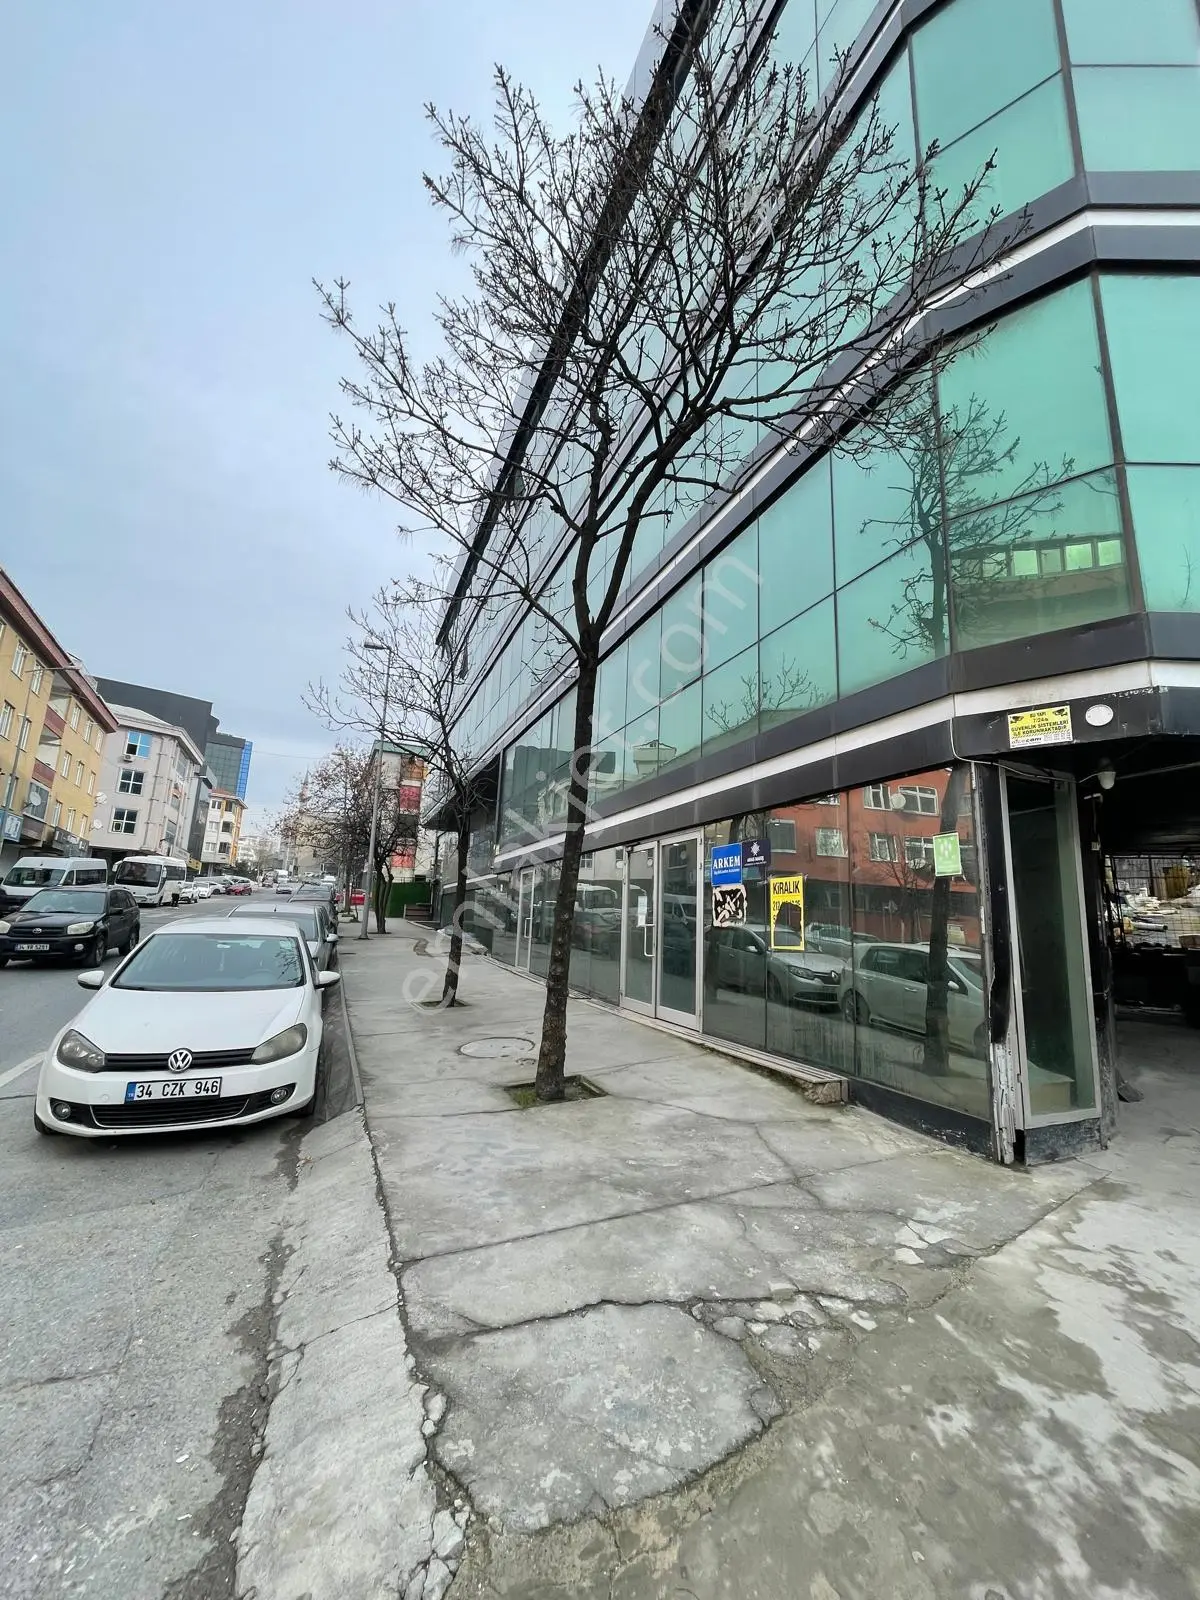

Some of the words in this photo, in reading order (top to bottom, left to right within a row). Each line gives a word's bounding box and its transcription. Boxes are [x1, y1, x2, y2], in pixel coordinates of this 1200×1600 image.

[713, 856, 741, 869] ARKEM
[136, 1084, 152, 1099] 34
[162, 1082, 186, 1097] CZK
[194, 1080, 219, 1095] 946
